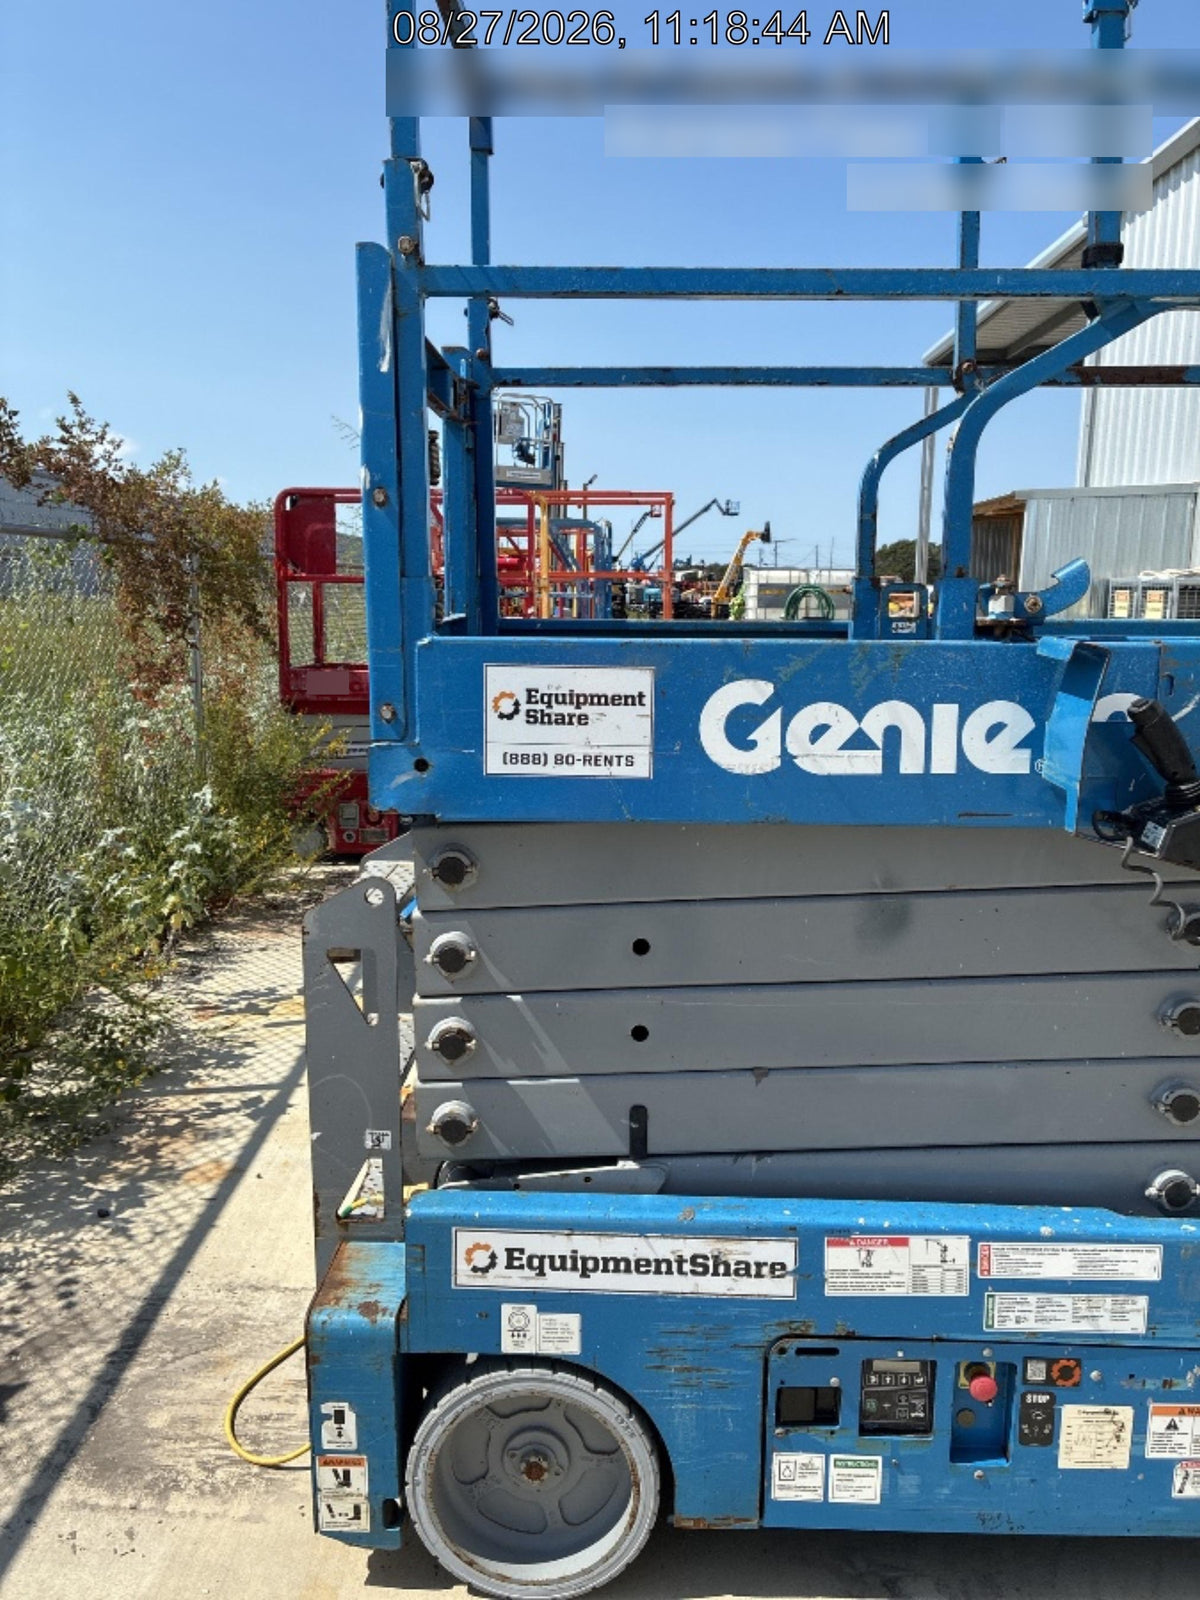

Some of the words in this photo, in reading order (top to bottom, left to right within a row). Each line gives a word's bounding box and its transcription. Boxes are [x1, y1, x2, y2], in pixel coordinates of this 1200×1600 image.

[525, 688, 647, 709] Equipment
[525, 708, 590, 726] Share
[699, 679, 1036, 776] Genie
[502, 752, 548, 767] (888)
[554, 753, 635, 767] 80-RENTS
[504, 1248, 787, 1279] EquipmentShare
